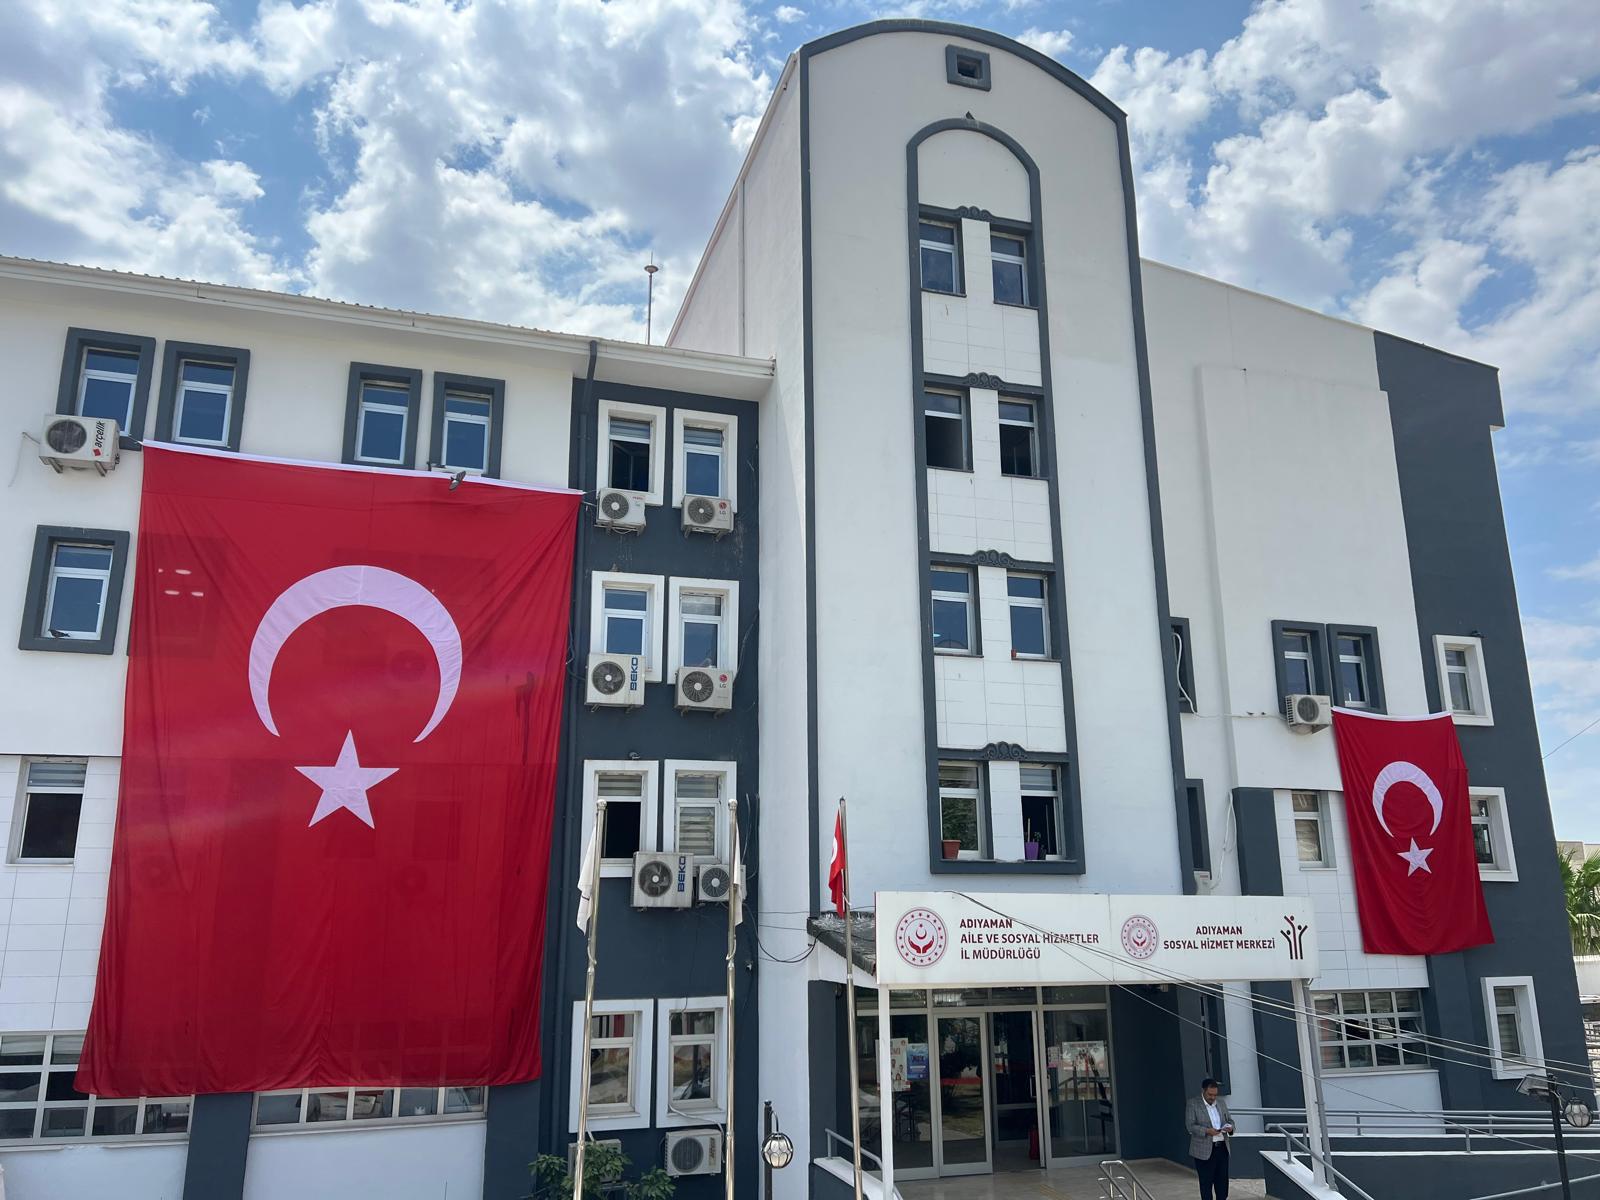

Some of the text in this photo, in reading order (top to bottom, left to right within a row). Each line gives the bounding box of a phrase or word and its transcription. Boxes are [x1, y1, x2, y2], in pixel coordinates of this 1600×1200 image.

[94, 420, 105, 448] arçelik
[630, 657, 638, 690] BEKO
[678, 855, 686, 892] BEKO
[960, 918, 1013, 928] ADIYAMAN
[1196, 926, 1243, 935] ADIYAMAN
[960, 931, 1099, 944] AİLE VE SOSYAL HİZMETLER
[1163, 937, 1275, 950] SOSYAL HİZMET MERKEZİ
[960, 947, 1041, 959] İL MÜDÜRLÜĞÜ
